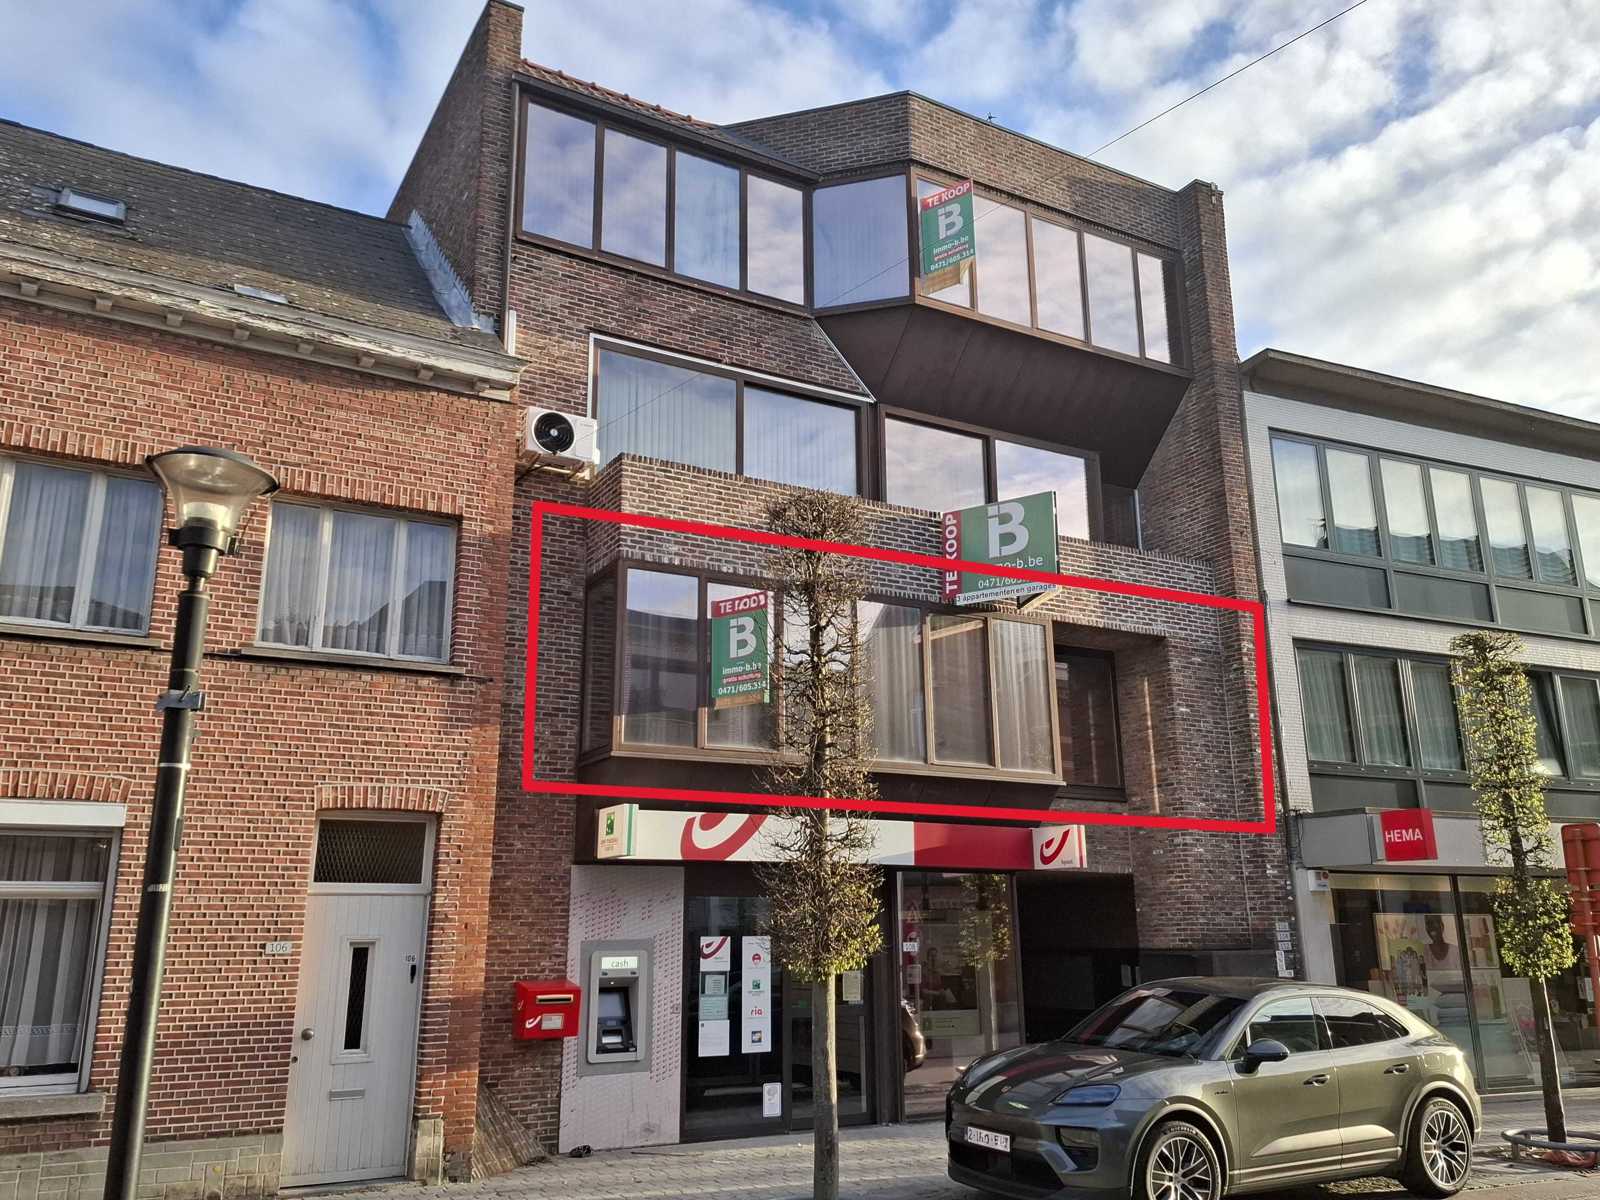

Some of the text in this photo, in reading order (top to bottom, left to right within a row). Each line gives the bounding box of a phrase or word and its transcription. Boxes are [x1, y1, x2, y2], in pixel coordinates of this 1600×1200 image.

[927, 182, 970, 207] TE KOOP
[946, 570, 957, 594] TE
[1026, 583, 1056, 594] garages
[719, 601, 733, 614] TE
[1385, 828, 1423, 843] HEMA
[270, 943, 288, 953] 106
[405, 954, 416, 962] 106
[611, 960, 629, 968] cash
[750, 1006, 763, 1016] ria
